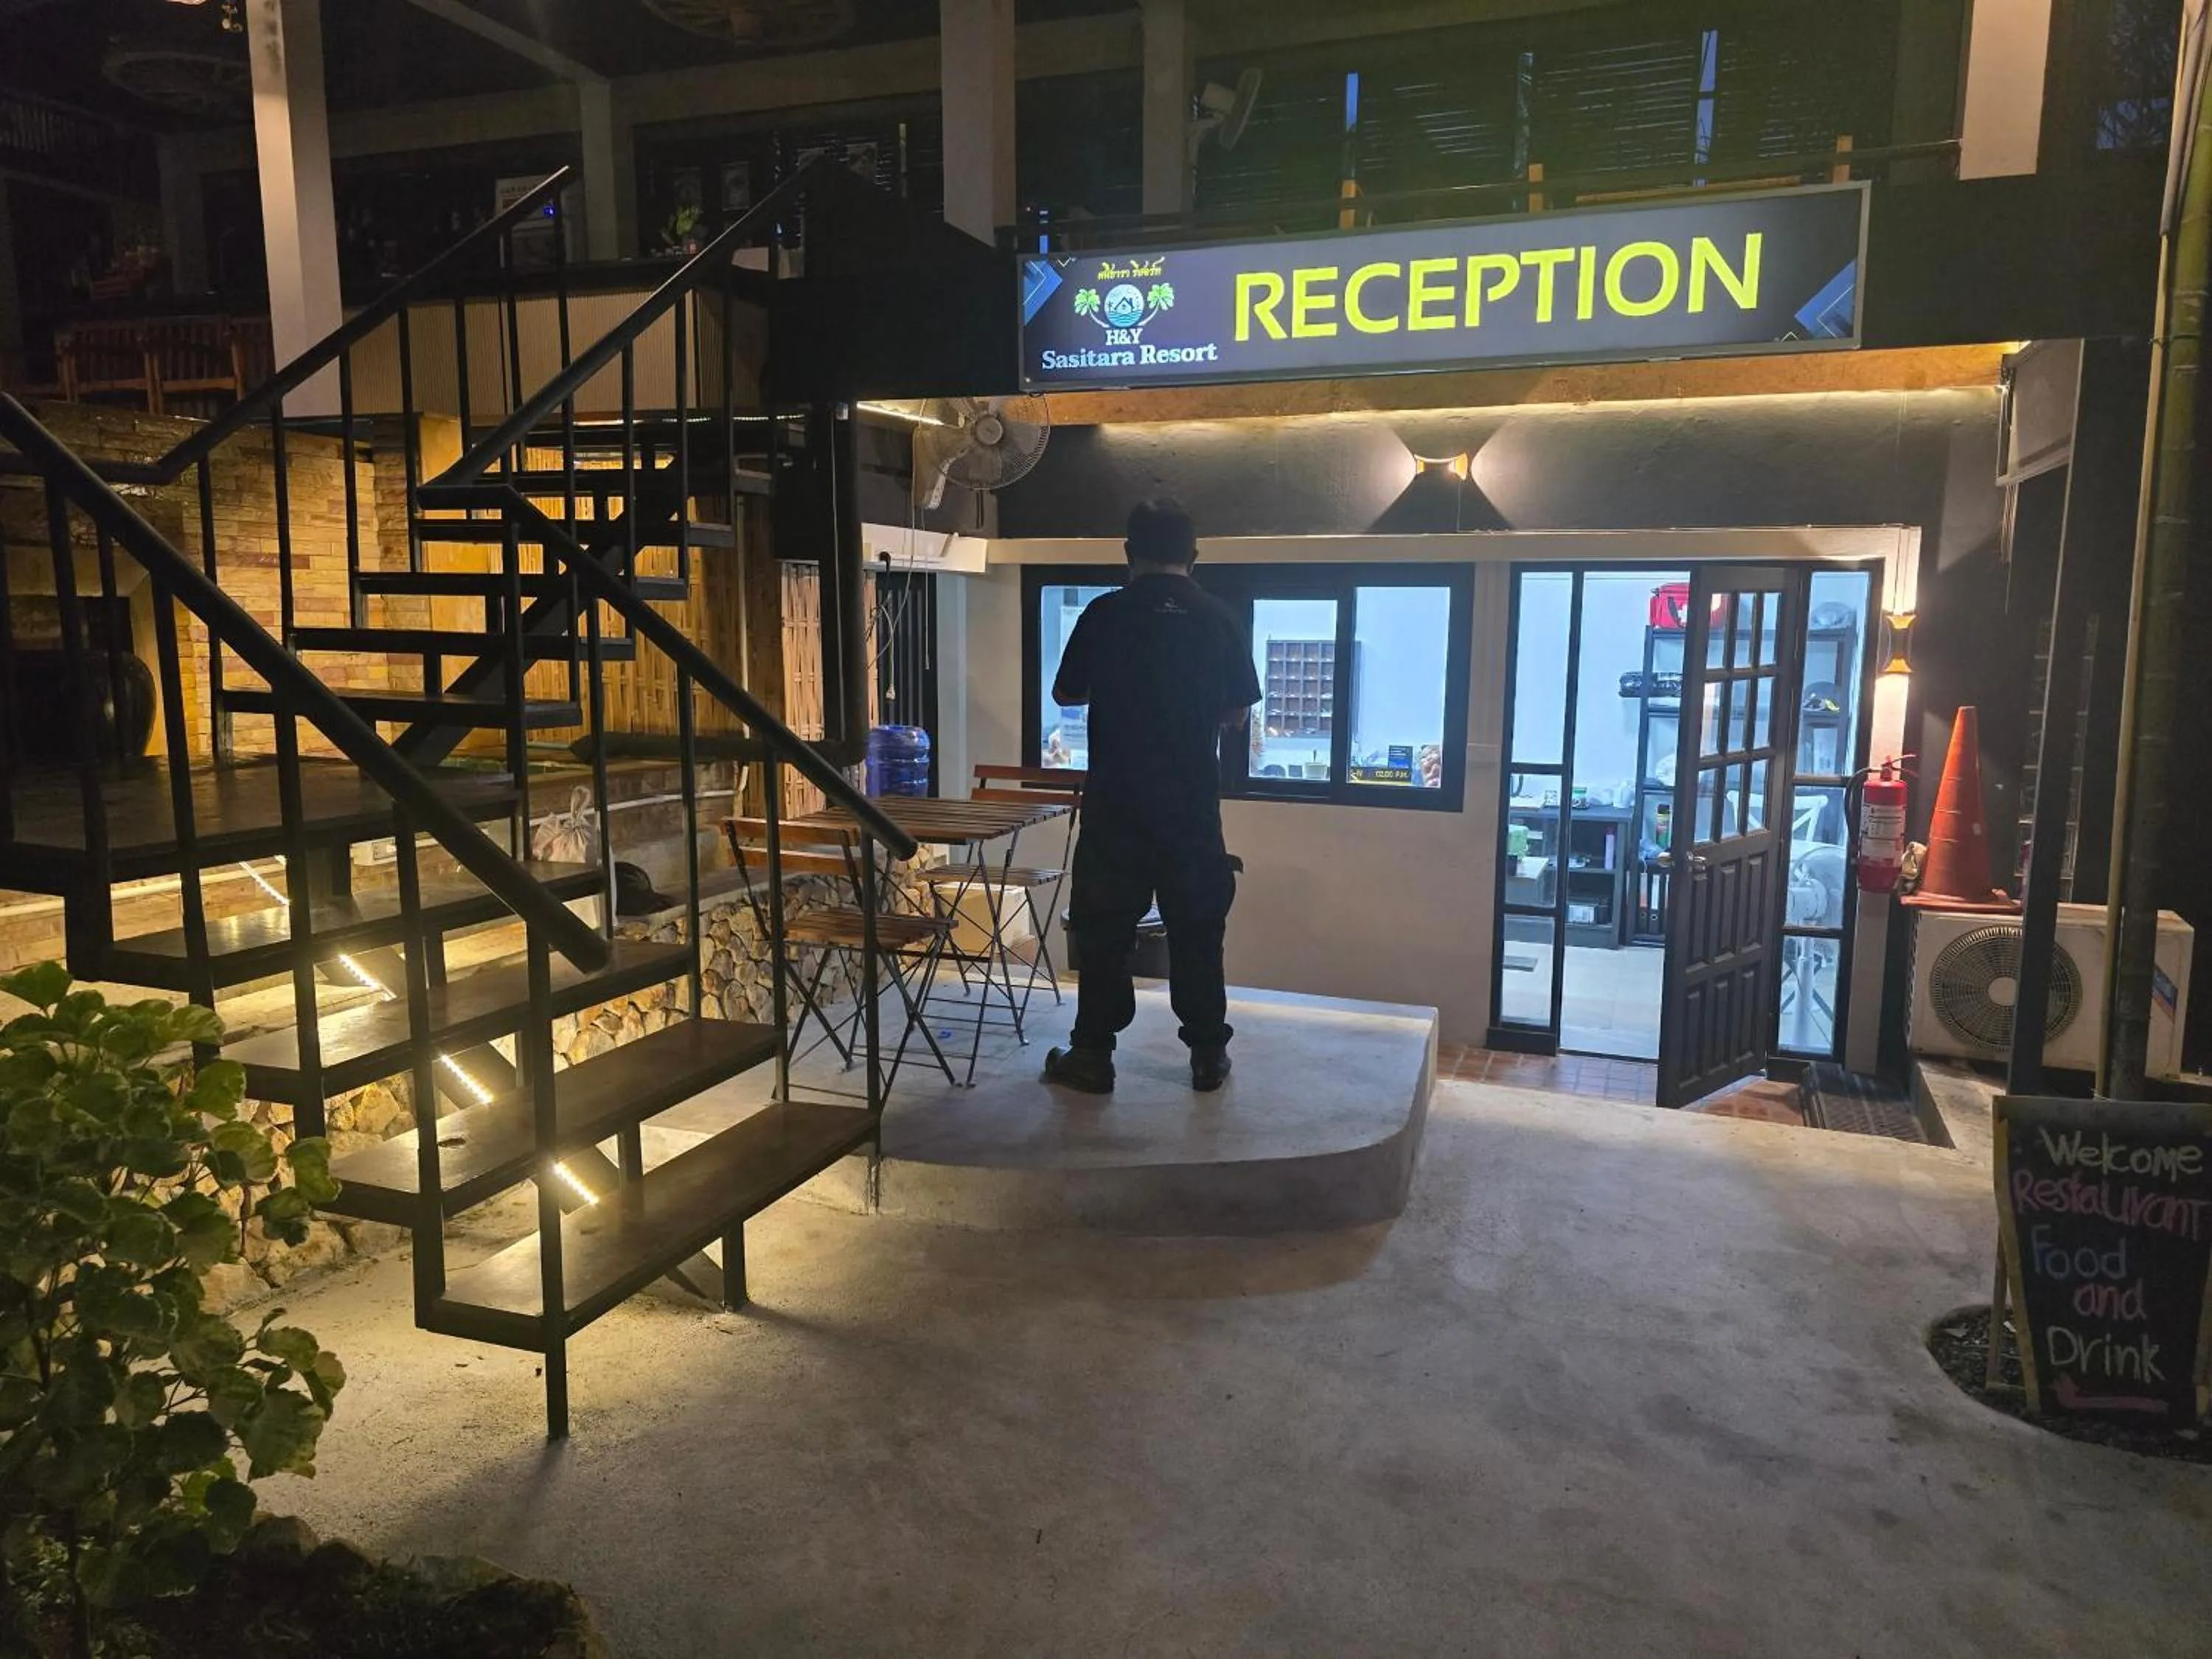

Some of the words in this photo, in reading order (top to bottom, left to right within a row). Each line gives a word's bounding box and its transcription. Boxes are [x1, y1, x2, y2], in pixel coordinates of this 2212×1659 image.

[1234, 232, 1762, 341] RECEPTION
[1042, 348, 1135, 369] Sasitara
[1139, 342, 1219, 365] Resort
[1105, 328, 1143, 346] H&Y
[2037, 1125, 2203, 1183] Welcome
[2031, 1224, 2127, 1280] Food
[2073, 1278, 2147, 1321] and
[2047, 1326, 2166, 1384] Drink
